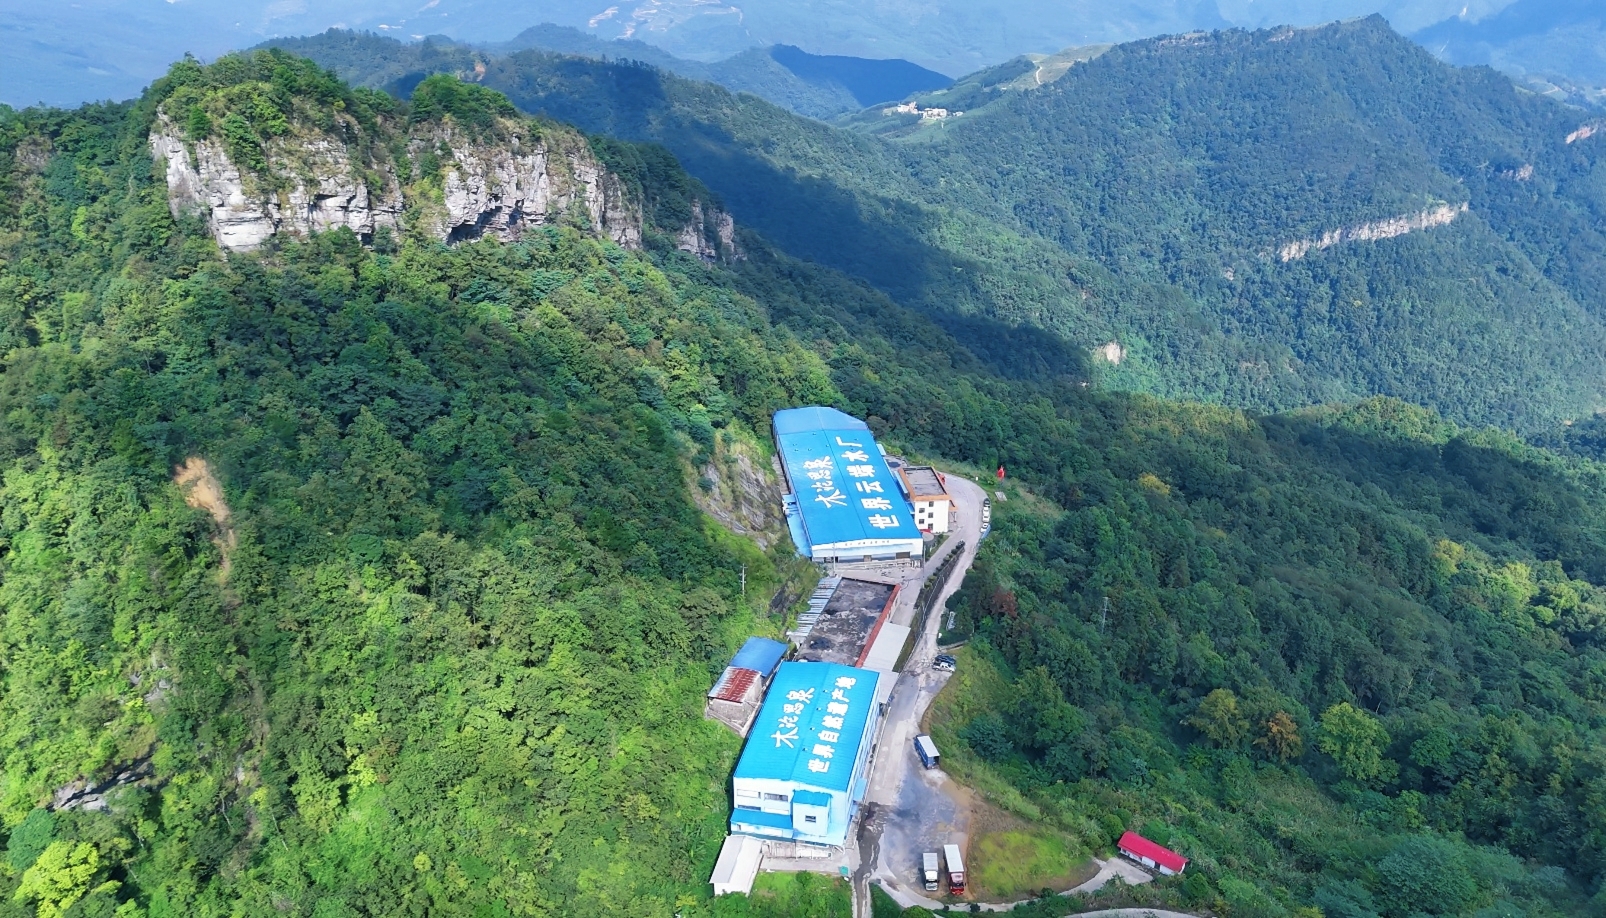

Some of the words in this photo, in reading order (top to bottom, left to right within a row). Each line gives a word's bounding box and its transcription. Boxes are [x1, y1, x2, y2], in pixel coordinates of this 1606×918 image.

[836, 437, 899, 529] 世界云端水厂
[808, 677, 856, 772] 世界自然遗产地
